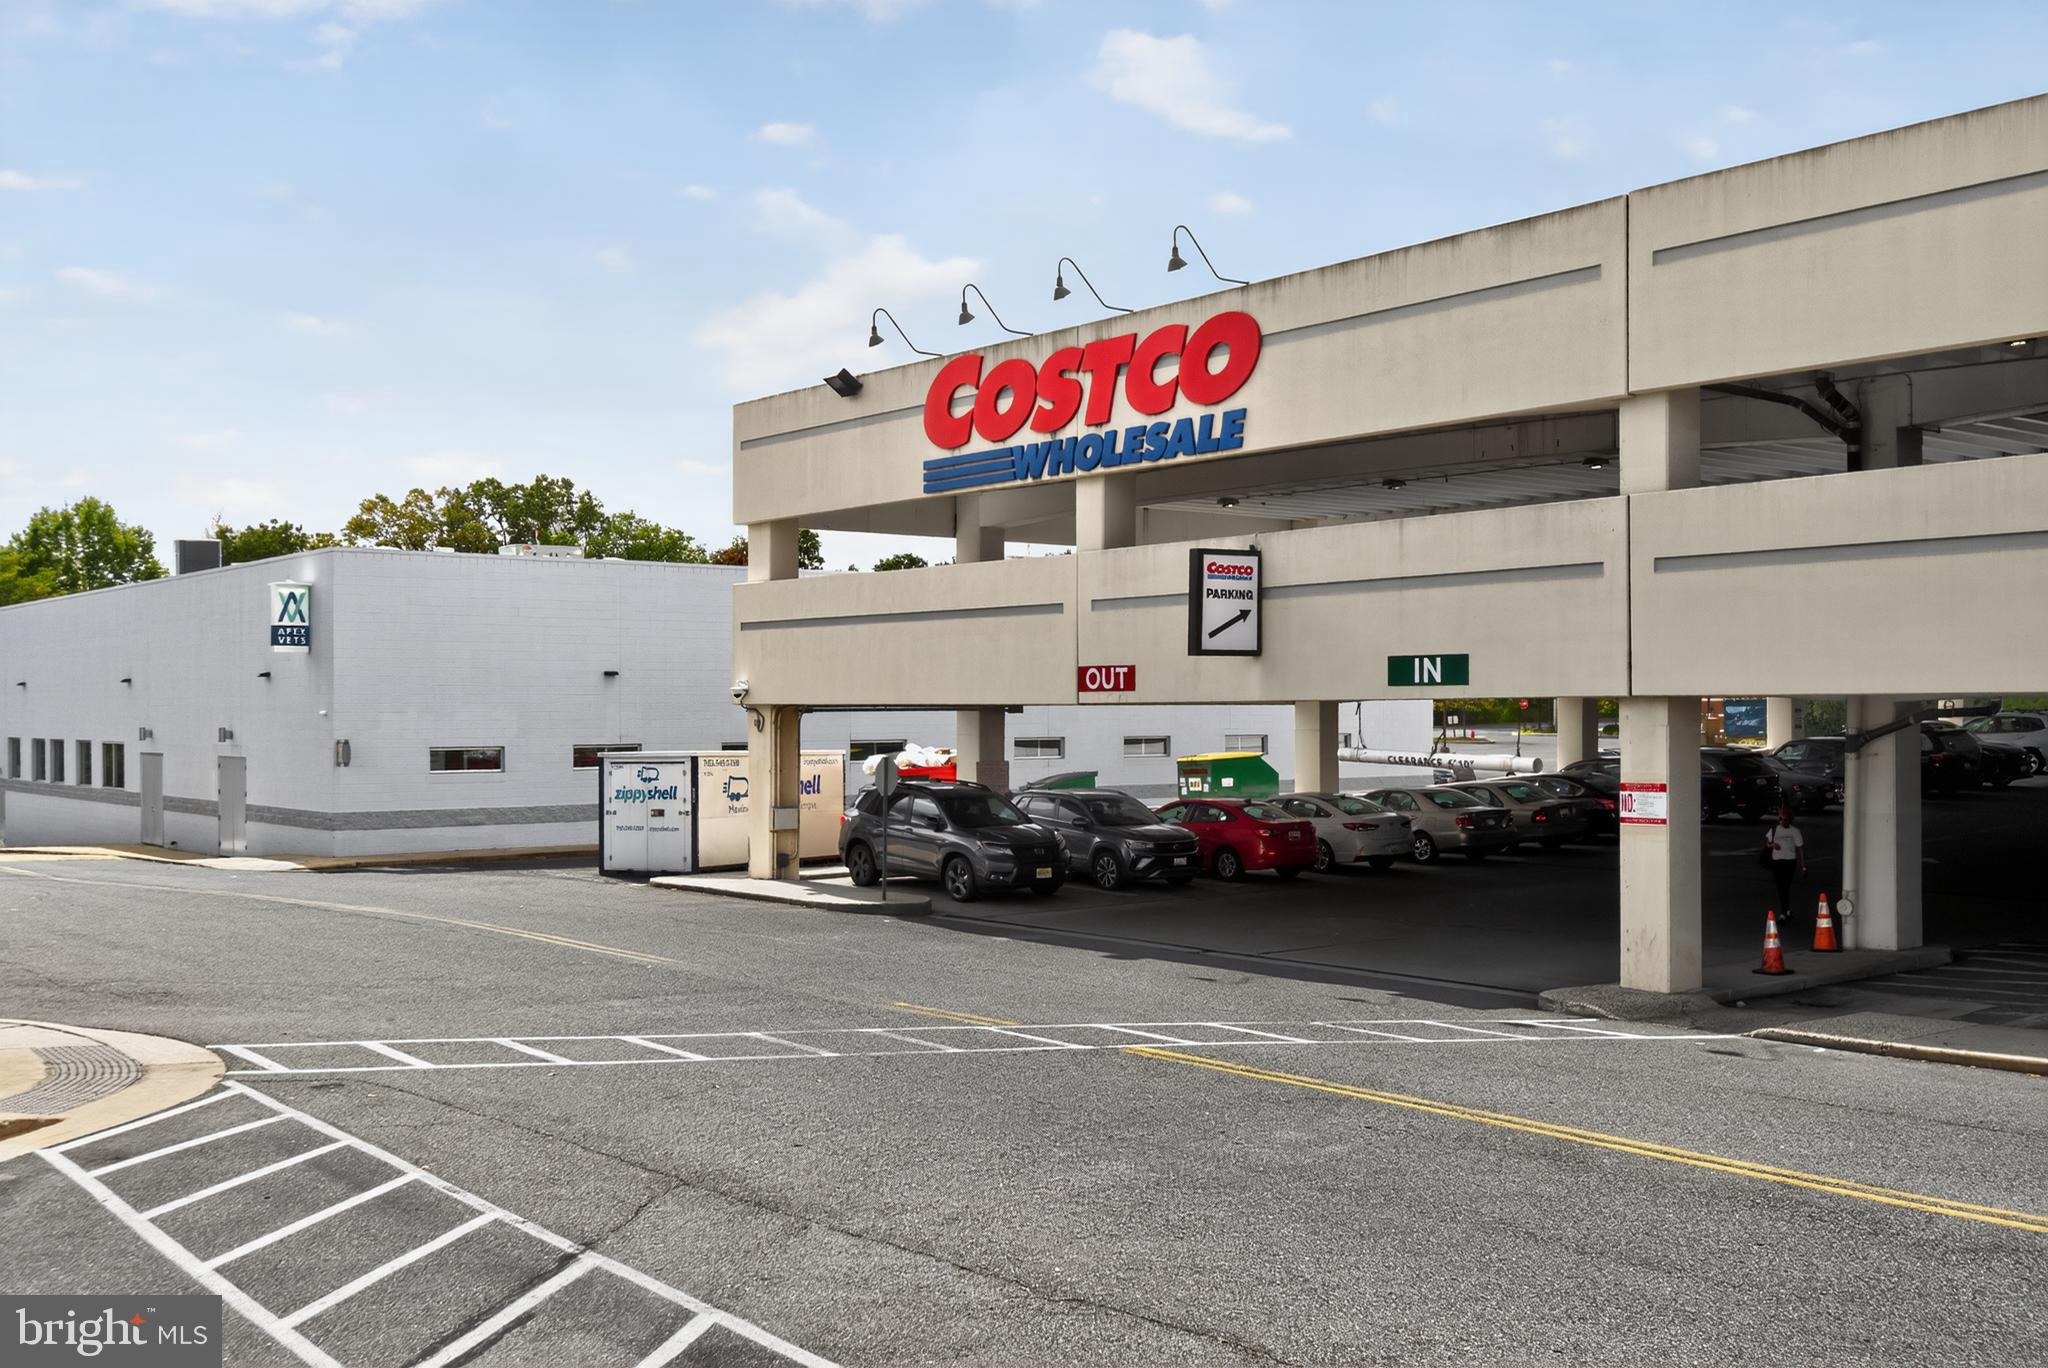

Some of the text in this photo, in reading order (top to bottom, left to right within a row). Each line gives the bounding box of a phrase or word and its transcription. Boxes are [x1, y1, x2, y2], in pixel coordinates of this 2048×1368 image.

[924, 311, 1262, 449] COSTCO
[1012, 408, 1248, 480] WHOLESALE
[1207, 561, 1254, 576] COSTCO
[1206, 588, 1254, 601] PARKING
[277, 636, 306, 645] VETS
[1085, 667, 1129, 690] OUT
[1413, 656, 1442, 684] IN
